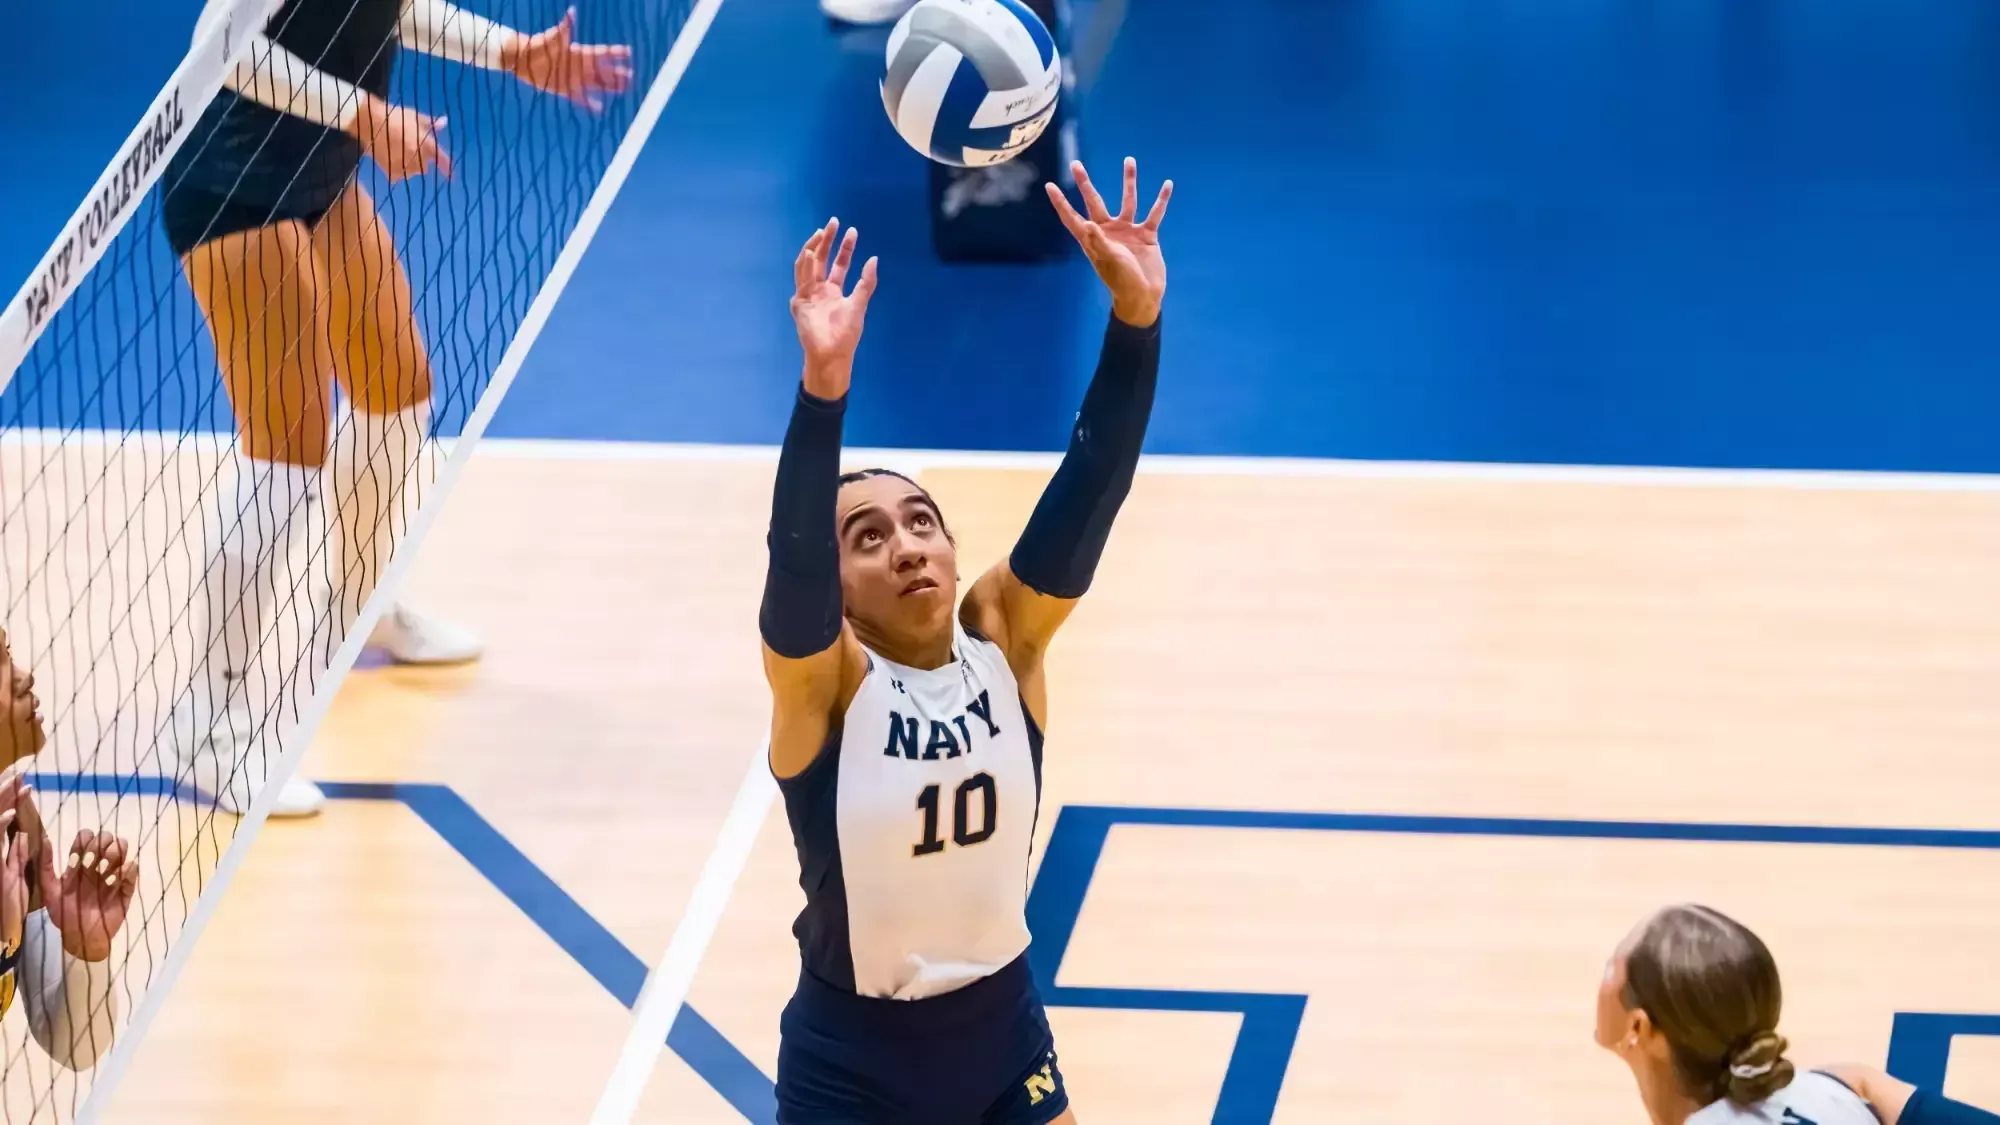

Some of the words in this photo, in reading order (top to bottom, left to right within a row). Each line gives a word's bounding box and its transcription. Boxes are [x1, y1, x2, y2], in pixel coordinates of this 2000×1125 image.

[78, 86, 184, 265] VOLLEYBALL
[911, 770, 998, 858] 10
[1023, 1062, 1057, 1106] N
